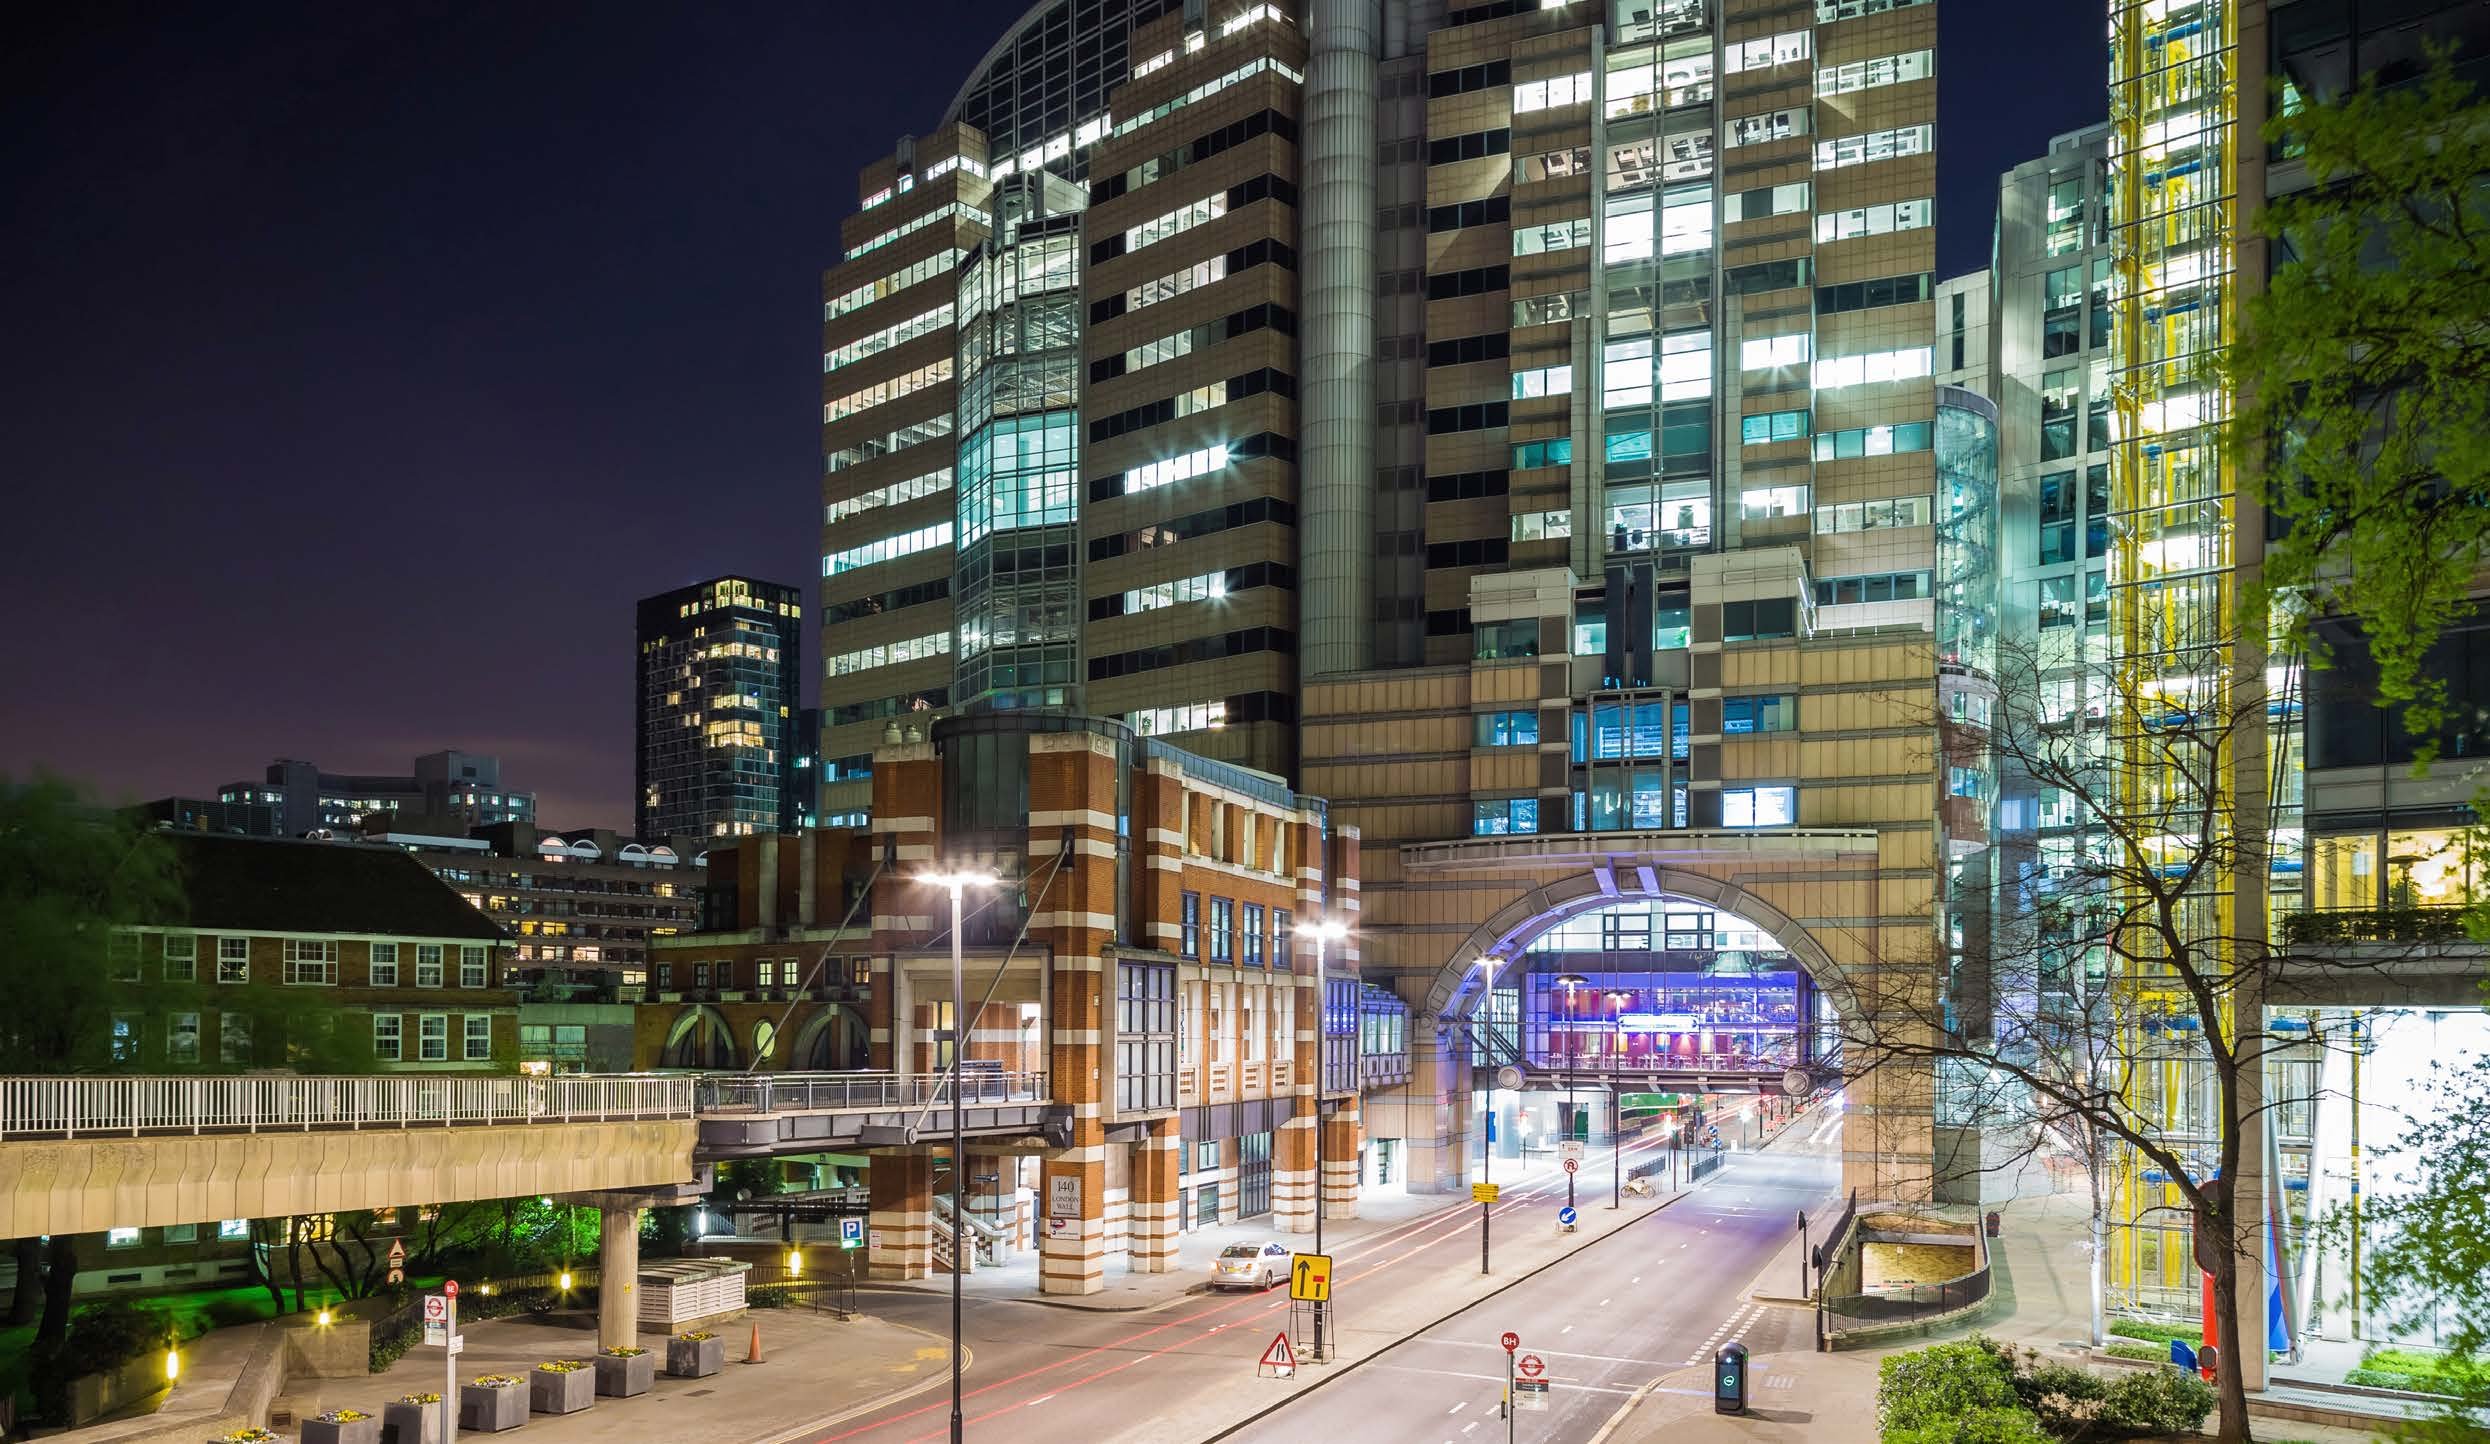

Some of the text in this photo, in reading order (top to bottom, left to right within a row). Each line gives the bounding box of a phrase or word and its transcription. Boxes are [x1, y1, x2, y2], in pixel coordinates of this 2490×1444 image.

[1057, 1181, 1075, 1193] 140
[846, 1222, 857, 1238] P
[1503, 1337, 1517, 1346] BH
